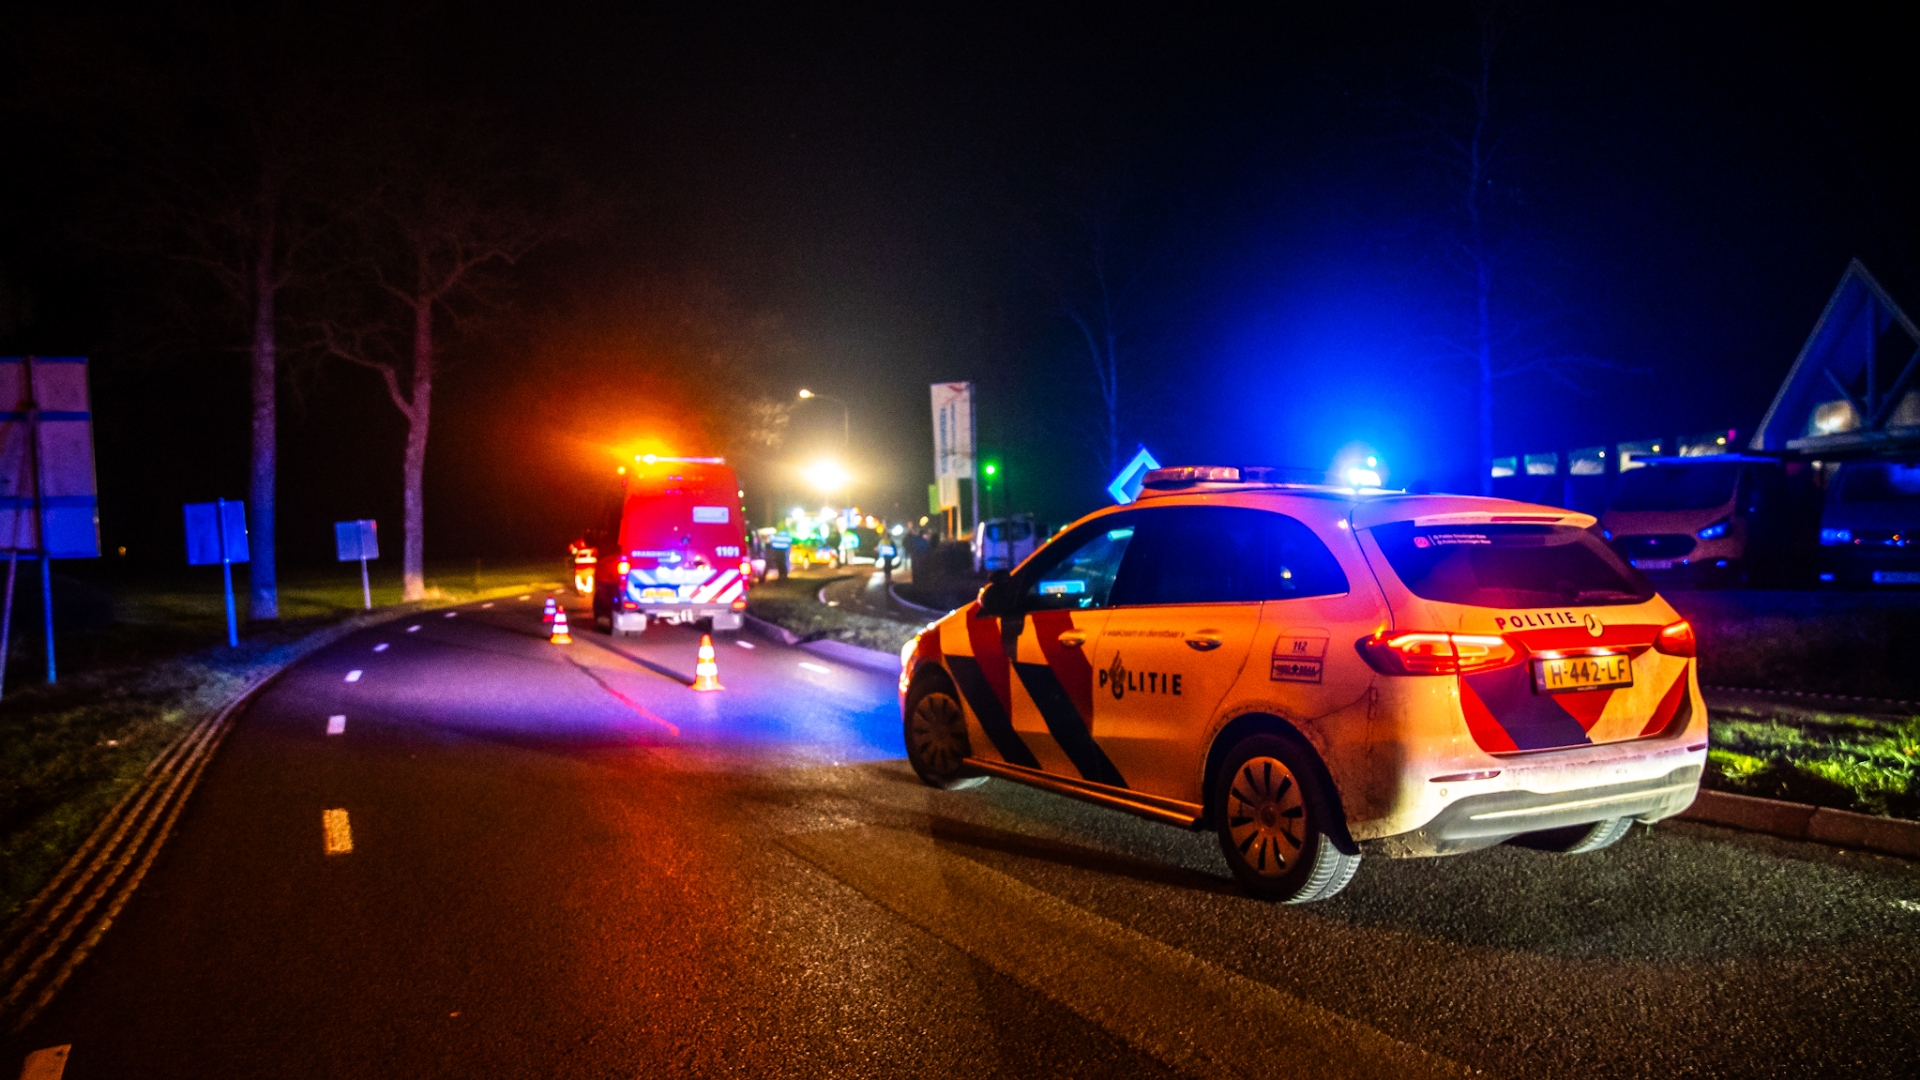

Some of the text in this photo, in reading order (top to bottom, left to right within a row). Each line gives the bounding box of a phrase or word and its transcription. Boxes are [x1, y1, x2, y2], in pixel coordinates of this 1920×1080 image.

[716, 546, 740, 557] 1101
[1494, 611, 1577, 630] POLITIE
[1293, 641, 1308, 651] 112
[1551, 659, 1625, 684] H-442-LF
[1099, 667, 1182, 699] POLITIE
